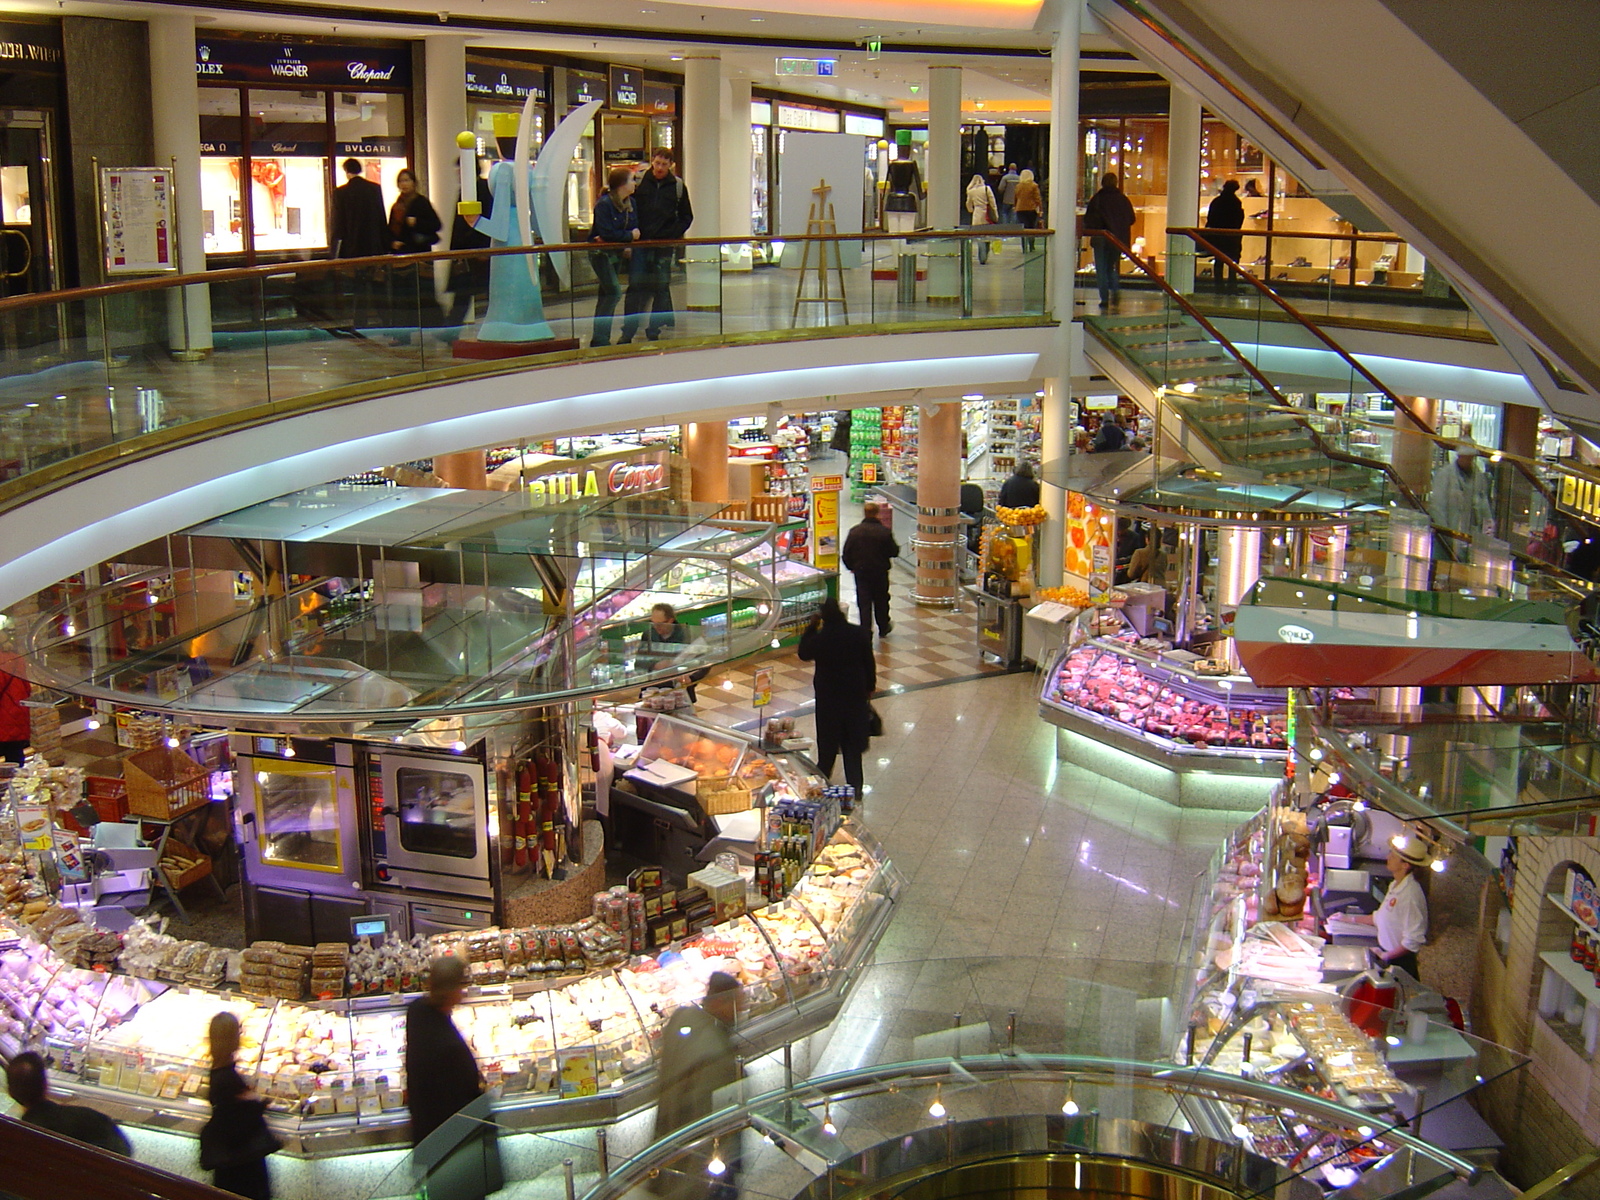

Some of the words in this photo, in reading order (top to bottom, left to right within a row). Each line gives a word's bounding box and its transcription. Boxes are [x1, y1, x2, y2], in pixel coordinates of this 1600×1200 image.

[271, 64, 309, 78] WAGNER
[347, 61, 396, 83] Chopard
[495, 84, 514, 95] OMEGA
[617, 90, 638, 105] WAGNER
[272, 143, 297, 153] Chopard
[344, 144, 391, 153] BVLGARI
[529, 470, 600, 509] BILLA
[608, 460, 665, 494] Corso
